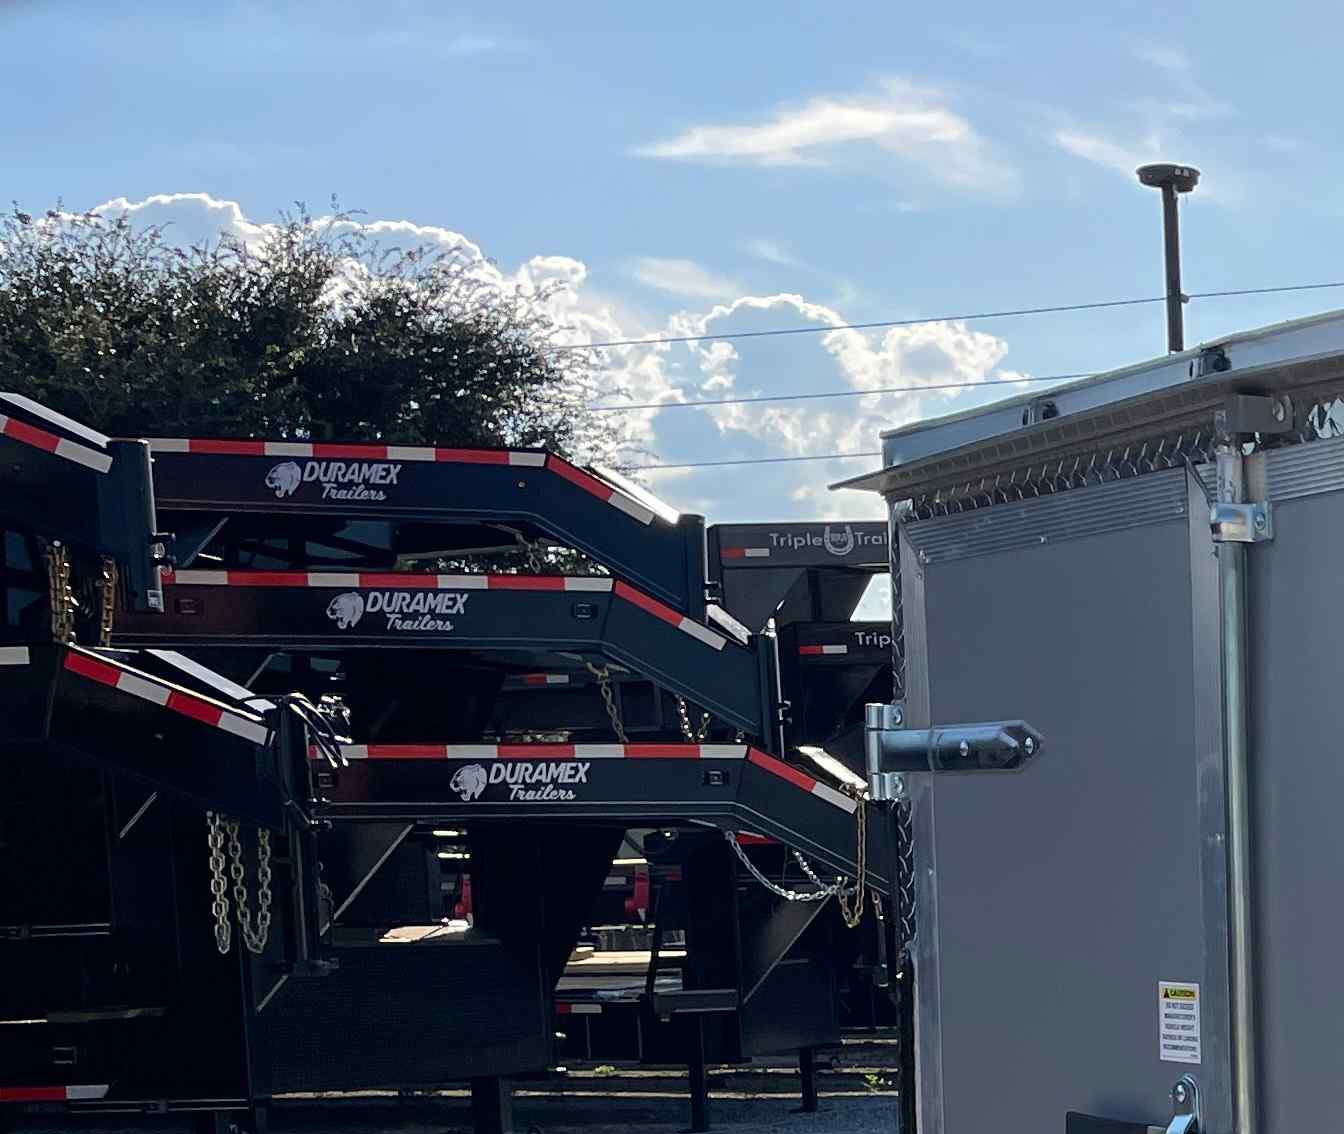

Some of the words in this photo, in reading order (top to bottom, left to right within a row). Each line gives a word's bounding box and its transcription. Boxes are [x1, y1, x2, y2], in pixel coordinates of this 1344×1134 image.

[303, 462, 401, 484] DURAMEX
[322, 483, 386, 500] Trailers
[769, 532, 822, 550] Triple
[366, 592, 468, 614] DURAMEX
[386, 614, 454, 630] Trailers
[489, 762, 590, 784] DURAMEX
[509, 784, 576, 800] Trailers
